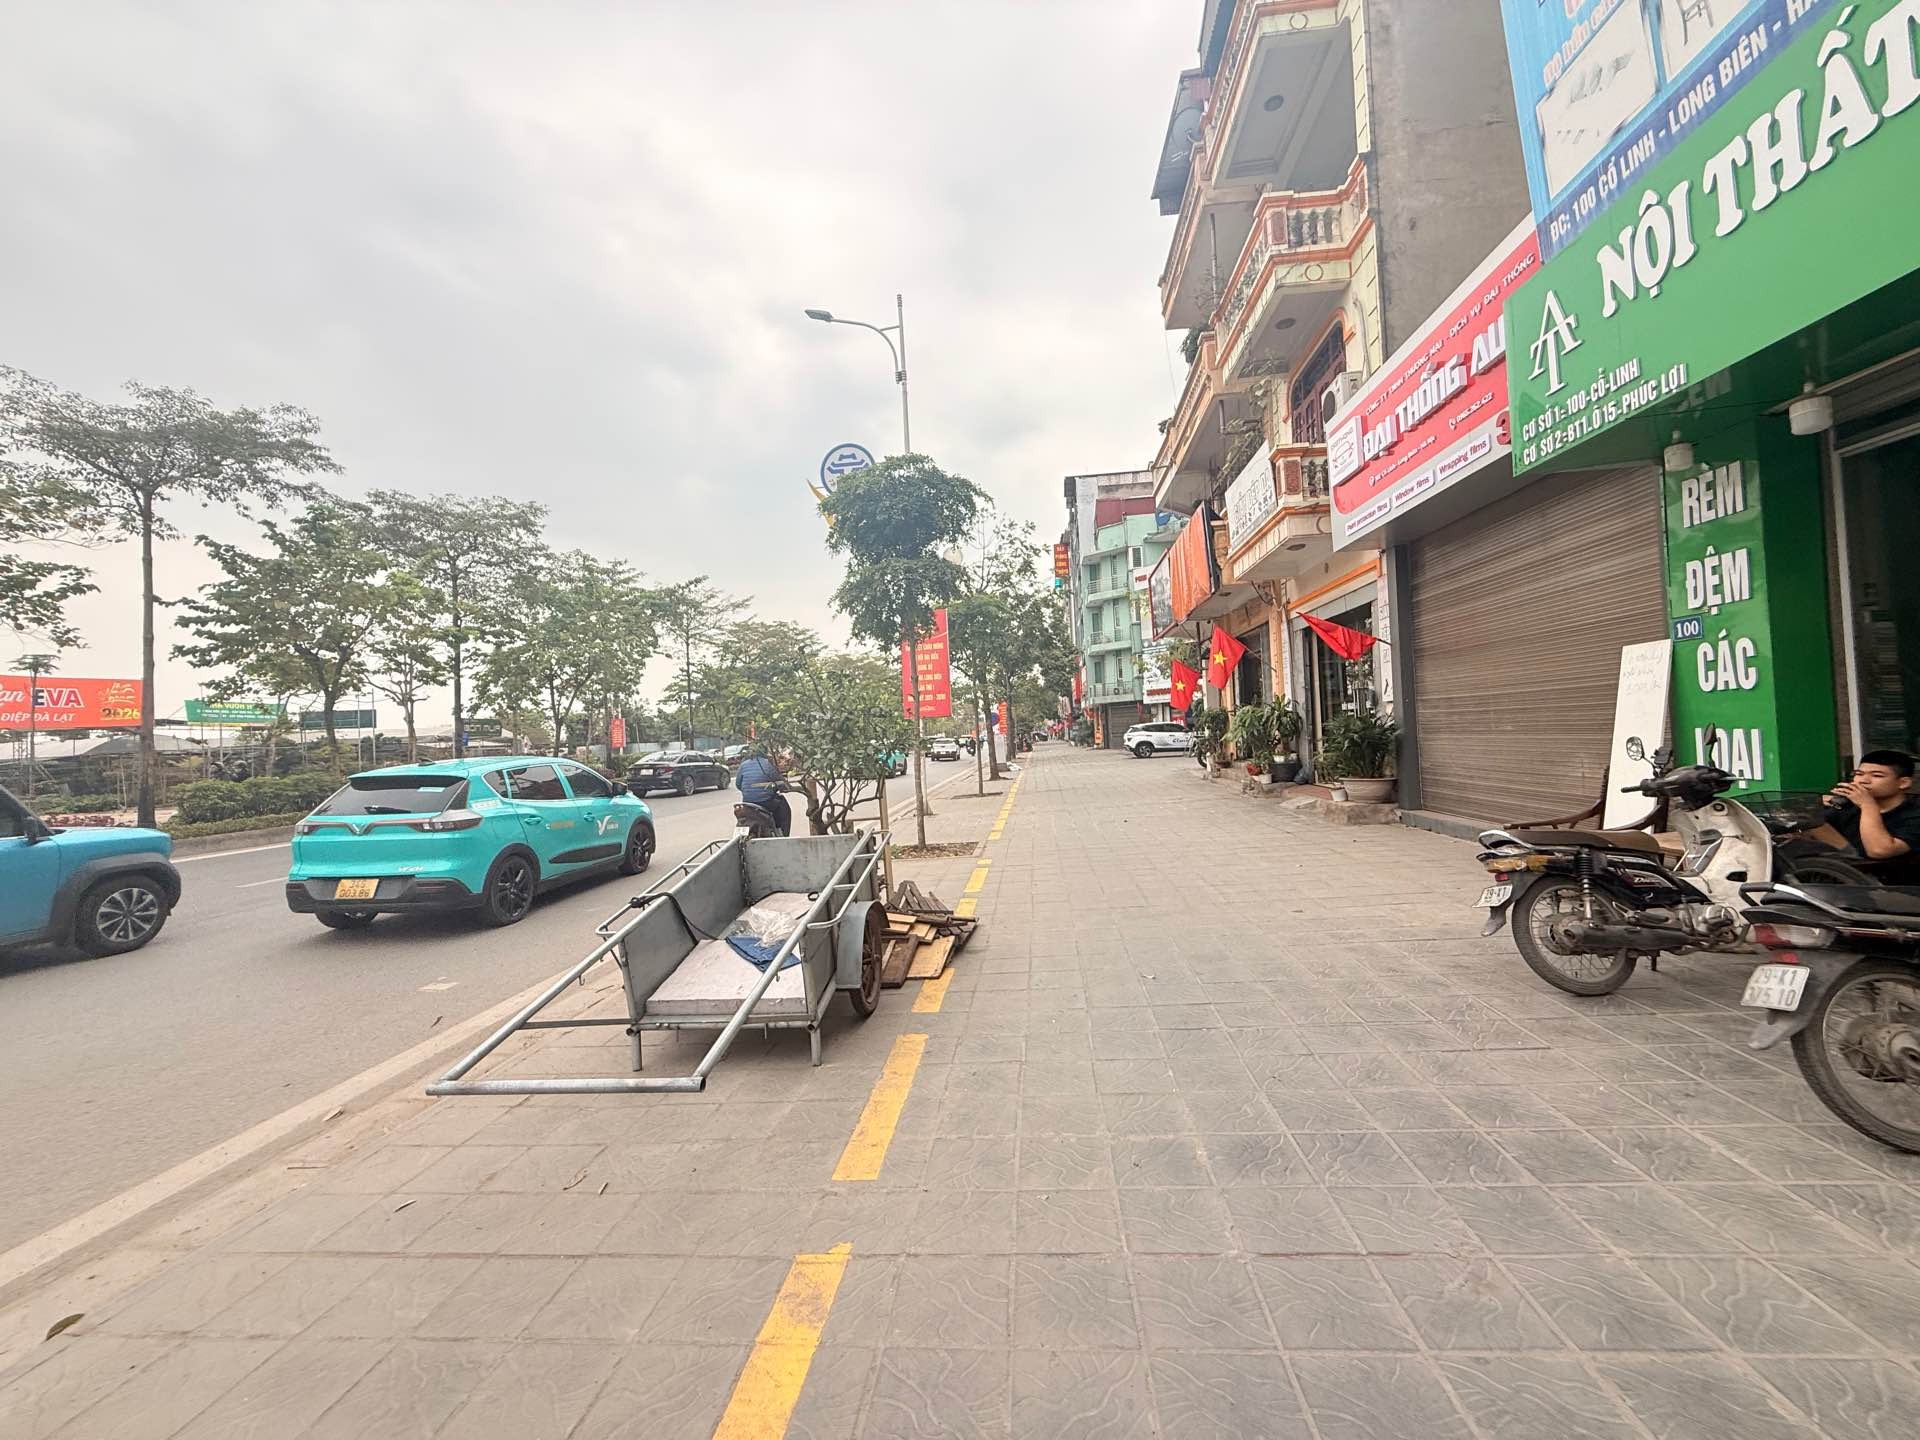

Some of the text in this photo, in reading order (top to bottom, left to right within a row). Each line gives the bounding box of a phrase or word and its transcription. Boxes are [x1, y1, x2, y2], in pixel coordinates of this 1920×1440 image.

[1550, 216, 1571, 243] ĐC:
[1573, 190, 1596, 222] 100
[1620, 129, 1656, 180] LINH
[1668, 84, 1715, 135] LONG
[1718, 23, 1768, 88] BIÊN
[1597, 181, 1697, 318] NỘI
[1363, 415, 1398, 461] ĐẠI
[1394, 353, 1470, 432] THỐNG
[1523, 443, 1536, 465] CƠ
[1661, 363, 1687, 394] LỢI
[1523, 418, 1536, 441] CƠ
[1439, 438, 1488, 476] Wrapping films
[1395, 487, 1415, 503] Window
[1685, 546, 1751, 615] ĐỆM
[1675, 620, 1700, 639] 100
[1696, 628, 1758, 692] CÁC
[31, 687, 84, 708] EVA
[54, 712, 76, 724] LẠT
